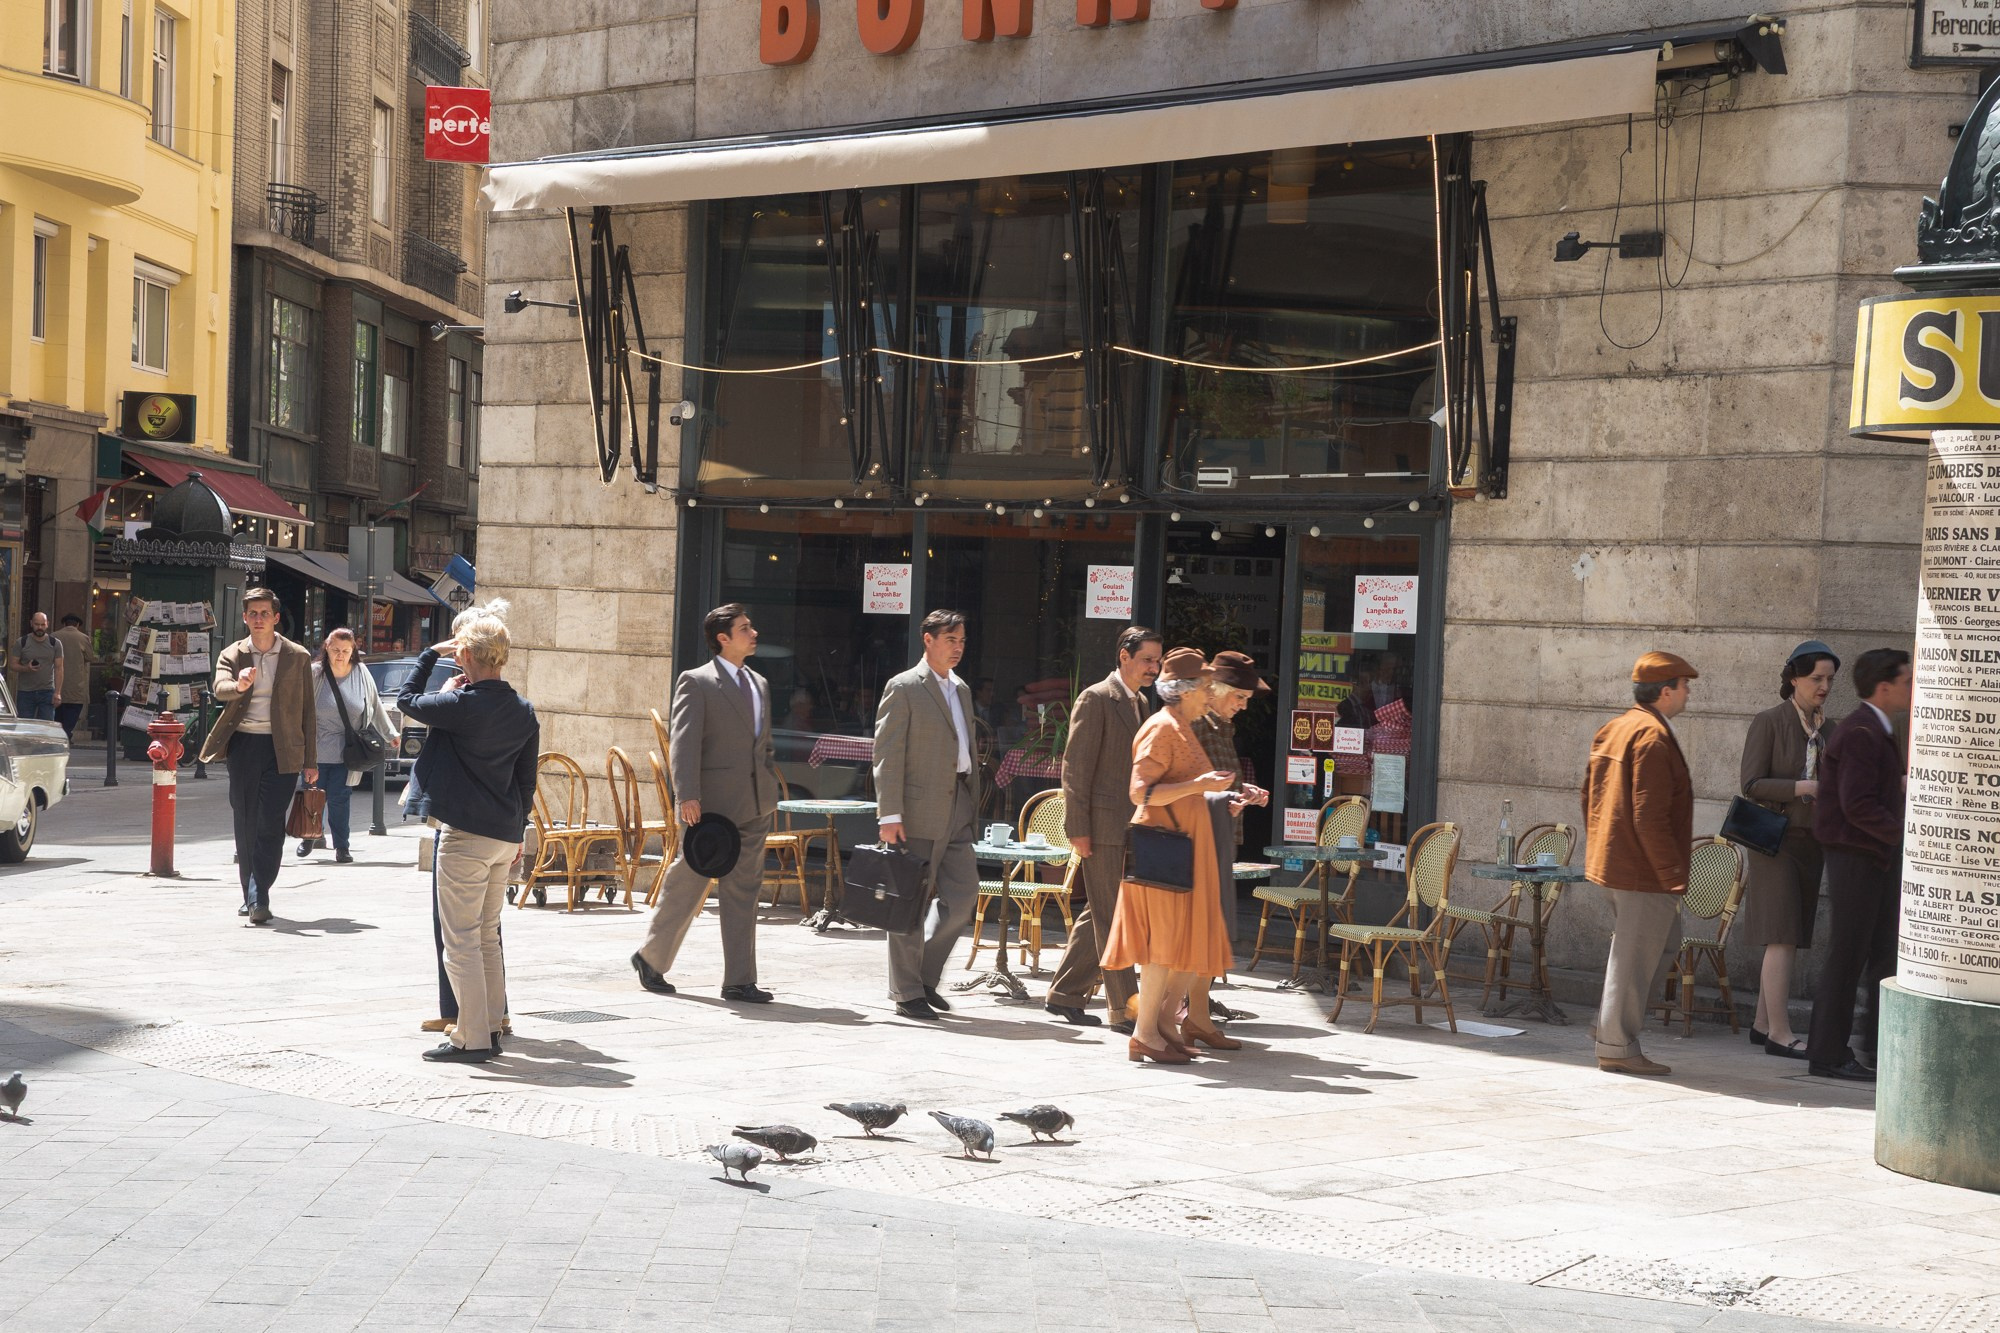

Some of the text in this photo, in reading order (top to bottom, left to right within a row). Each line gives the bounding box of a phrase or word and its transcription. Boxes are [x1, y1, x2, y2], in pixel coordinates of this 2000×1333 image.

[1931, 10, 2000, 36] Ferencie
[1952, 42, 1959, 53] 5
[1935, 463, 1983, 479] OMBRES
[1939, 493, 1975, 502] VALCOUR
[1969, 508, 1994, 516] ANDRÉ
[1952, 527, 1989, 541] SANS
[1943, 543, 1970, 551] RIVIÈRE
[1933, 556, 1967, 565] DUMONT
[1927, 587, 1981, 601] DERNIER
[1933, 615, 1957, 625] ARTOIS
[1921, 648, 1957, 661] MAISON
[1938, 665, 1965, 673] VIGNOL
[1938, 677, 1972, 687] ROCHET
[1980, 679, 2000, 688] Alai
[1920, 706, 1997, 724] CENDRES DU
[1930, 723, 1955, 732] VICTOR
[1926, 734, 1961, 745] DURAND
[1970, 737, 1995, 747] Alice
[1916, 767, 2000, 787] MASQUE TO
[1928, 784, 1953, 793] HENRI
[1957, 786, 2000, 797] VALMON
[1919, 794, 1952, 806] MERCIER
[1962, 798, 1987, 809] Rène
[1908, 821, 1917, 834] LA
[1920, 824, 1971, 841] SOURIS
[1928, 839, 1952, 850] ÉMILE
[1955, 843, 1995, 854] CARON
[1920, 850, 1952, 862] DELAGE
[1961, 856, 1980, 865] Lise
[1928, 886, 1952, 901] SUR
[1956, 890, 1975, 903] LA
[1923, 900, 1954, 910] ALBERT
[1959, 905, 1998, 916] DUROC
[1919, 910, 1952, 923] LEMAIRE
[1960, 915, 1982, 926] Paul
[1924, 934, 1959, 944] ST-GEORGES
[1964, 940, 1996, 948] TRUDAINE
[1919, 947, 1939, 960] 1.500
[1941, 952, 1951, 963] fr.
[1960, 953, 2000, 969] LOCATIO
[1915, 970, 1938, 980] DURAND
[1946, 977, 1968, 985] PARIS
